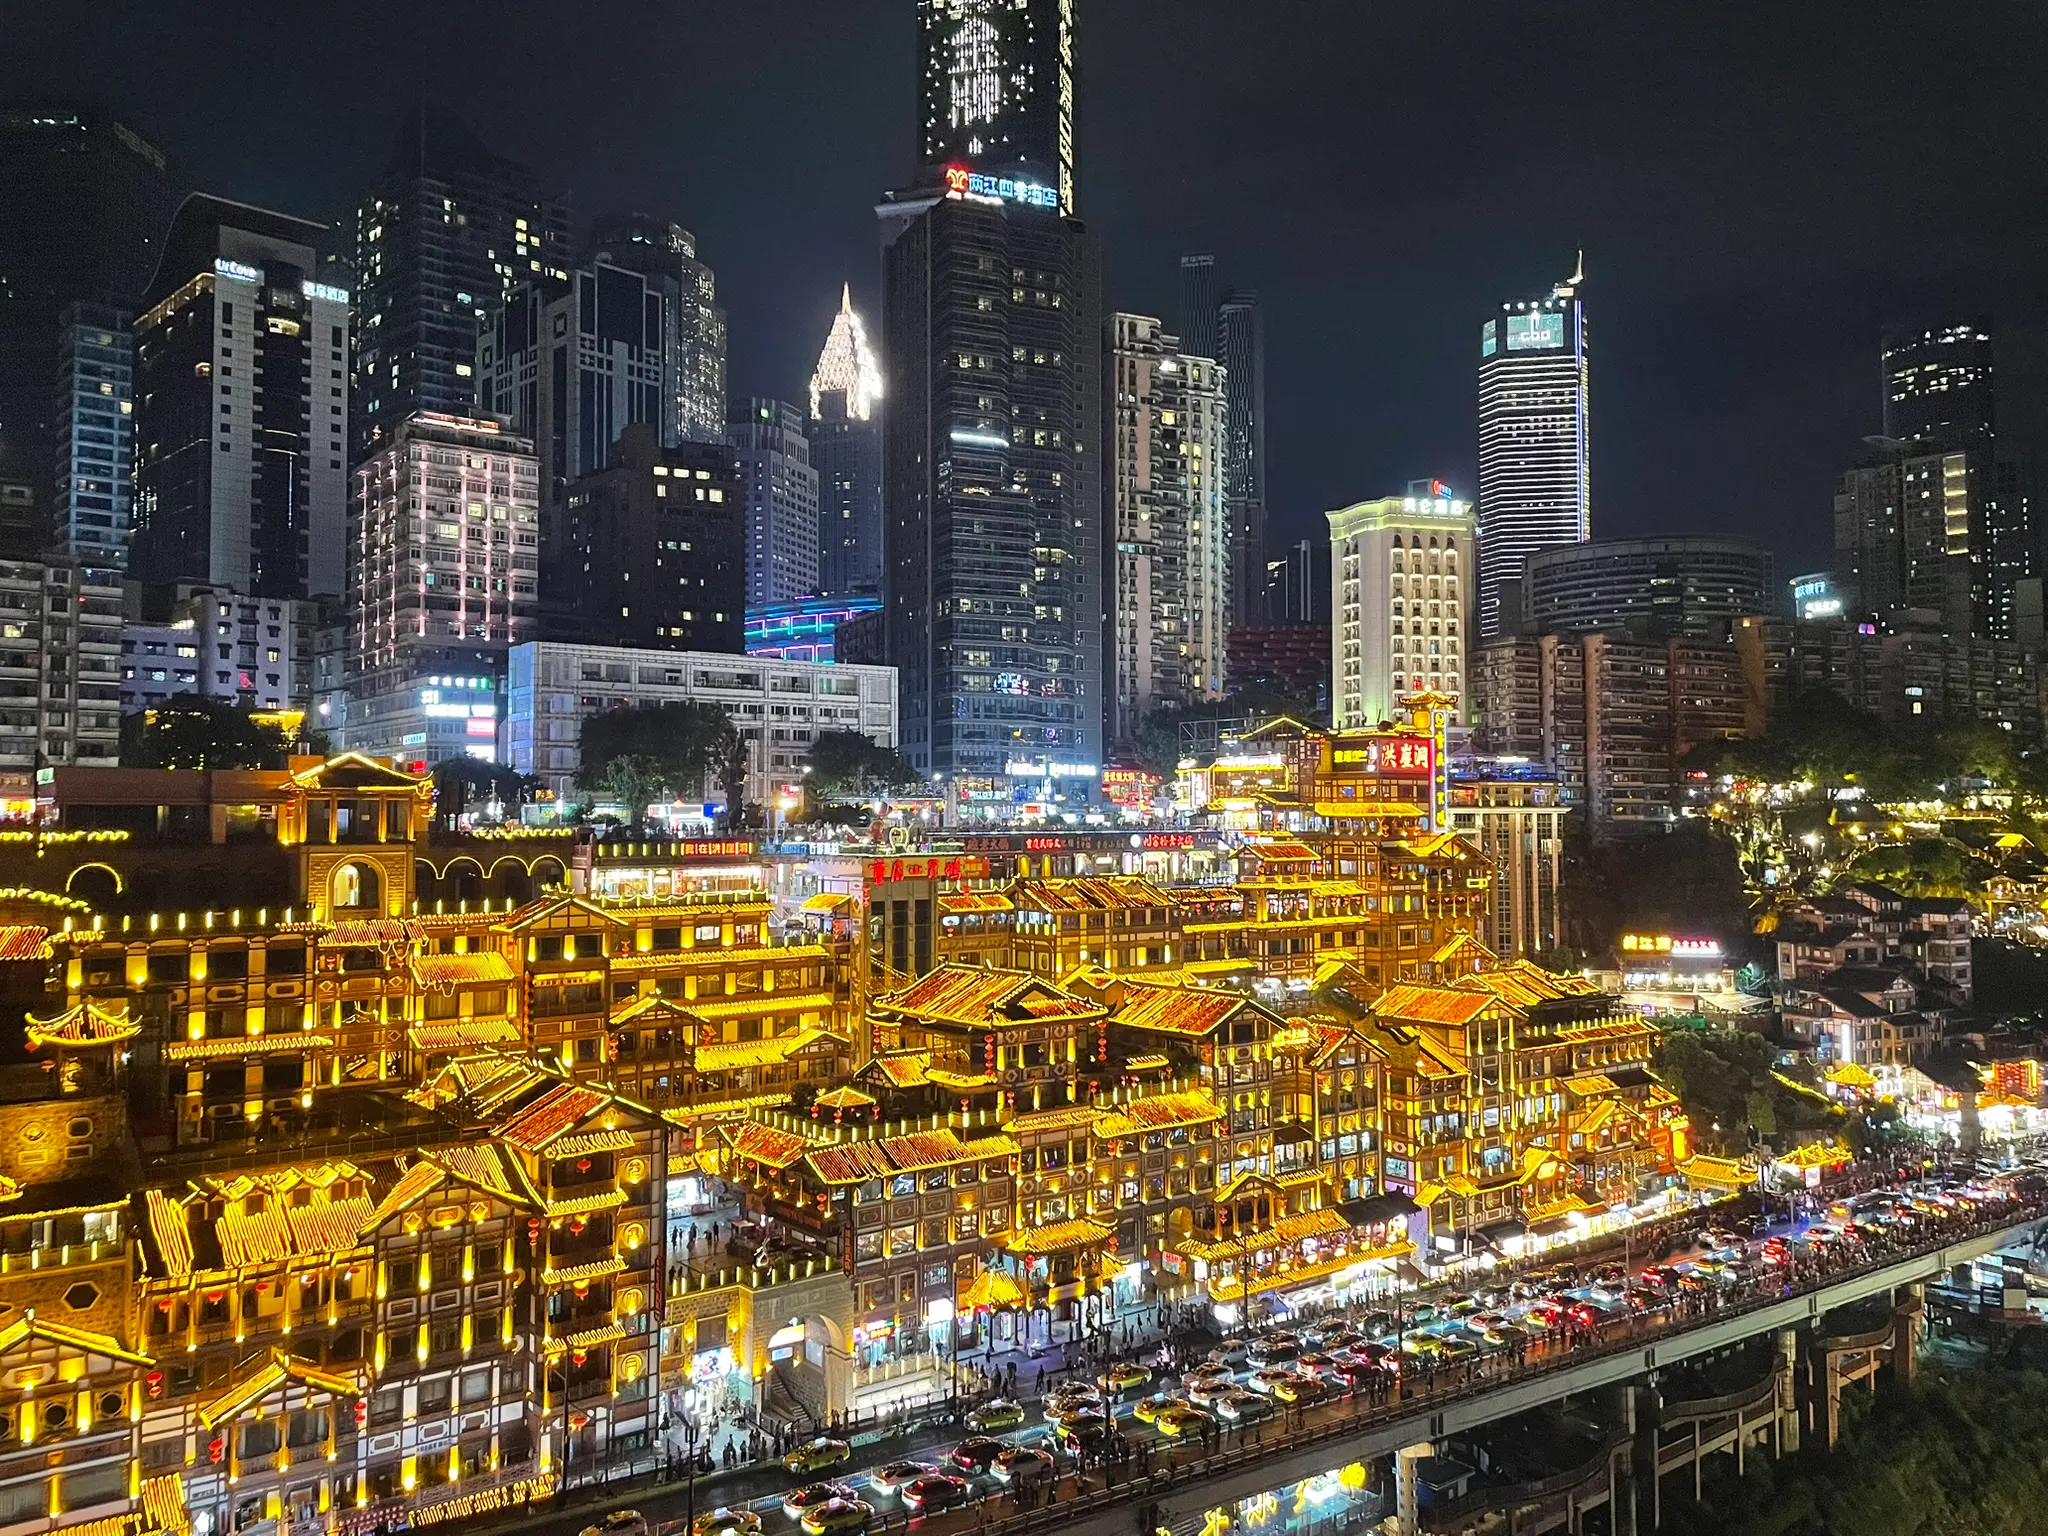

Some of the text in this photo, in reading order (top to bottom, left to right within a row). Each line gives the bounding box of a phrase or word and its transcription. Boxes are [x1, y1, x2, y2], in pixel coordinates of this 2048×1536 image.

[968, 172, 1058, 207] 两江四季酒店
[1381, 742, 1428, 768] 洪崖洞
[685, 842, 749, 855] 我在洪崖洞
